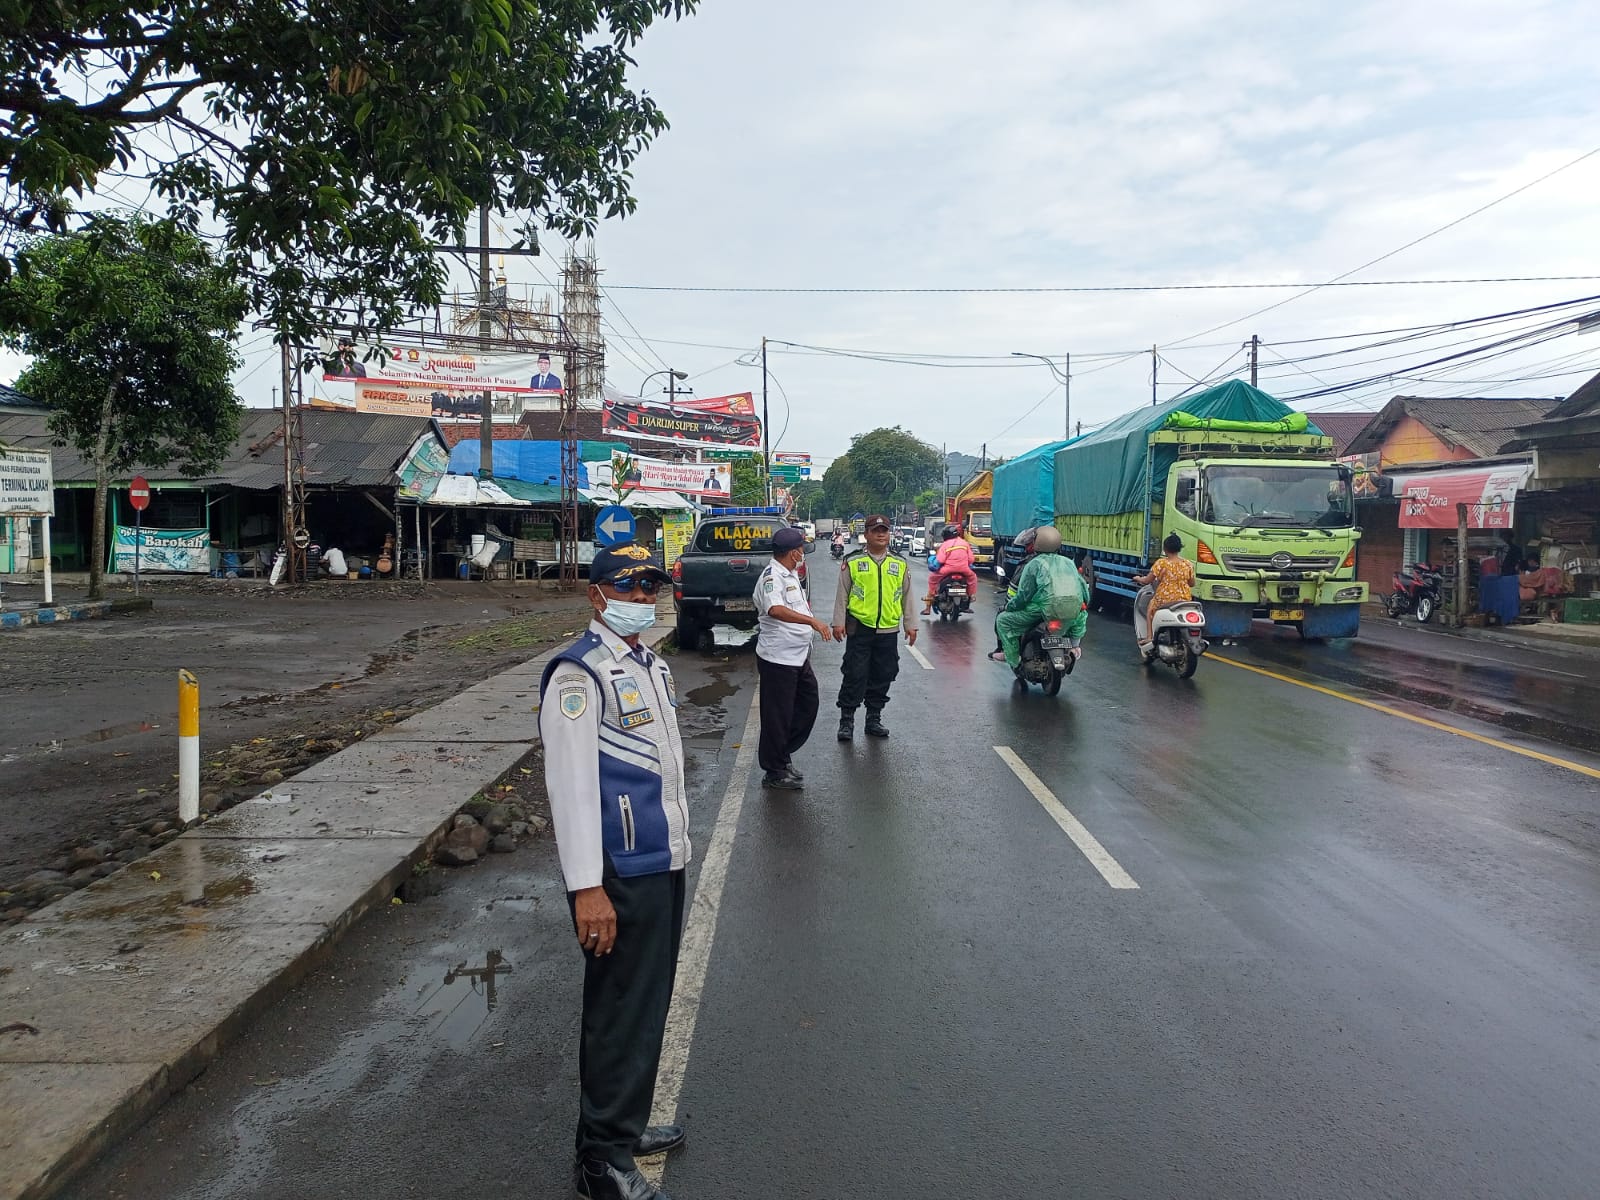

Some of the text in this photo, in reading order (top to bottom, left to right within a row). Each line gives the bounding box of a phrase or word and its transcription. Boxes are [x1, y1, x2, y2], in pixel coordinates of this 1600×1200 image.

[378, 369, 412, 380] Selamat
[465, 375, 492, 384] Ibadah
[494, 377, 518, 385] Puasa
[642, 416, 675, 430] DJARUM
[676, 422, 699, 432] SUPER
[2, 478, 48, 491] TERMINAL KLAKAH
[1429, 495, 1448, 508] Zona
[714, 526, 772, 539] KLAKAH
[144, 535, 204, 549] Barokah
[734, 540, 751, 550] 02
[628, 711, 652, 725] SULI
